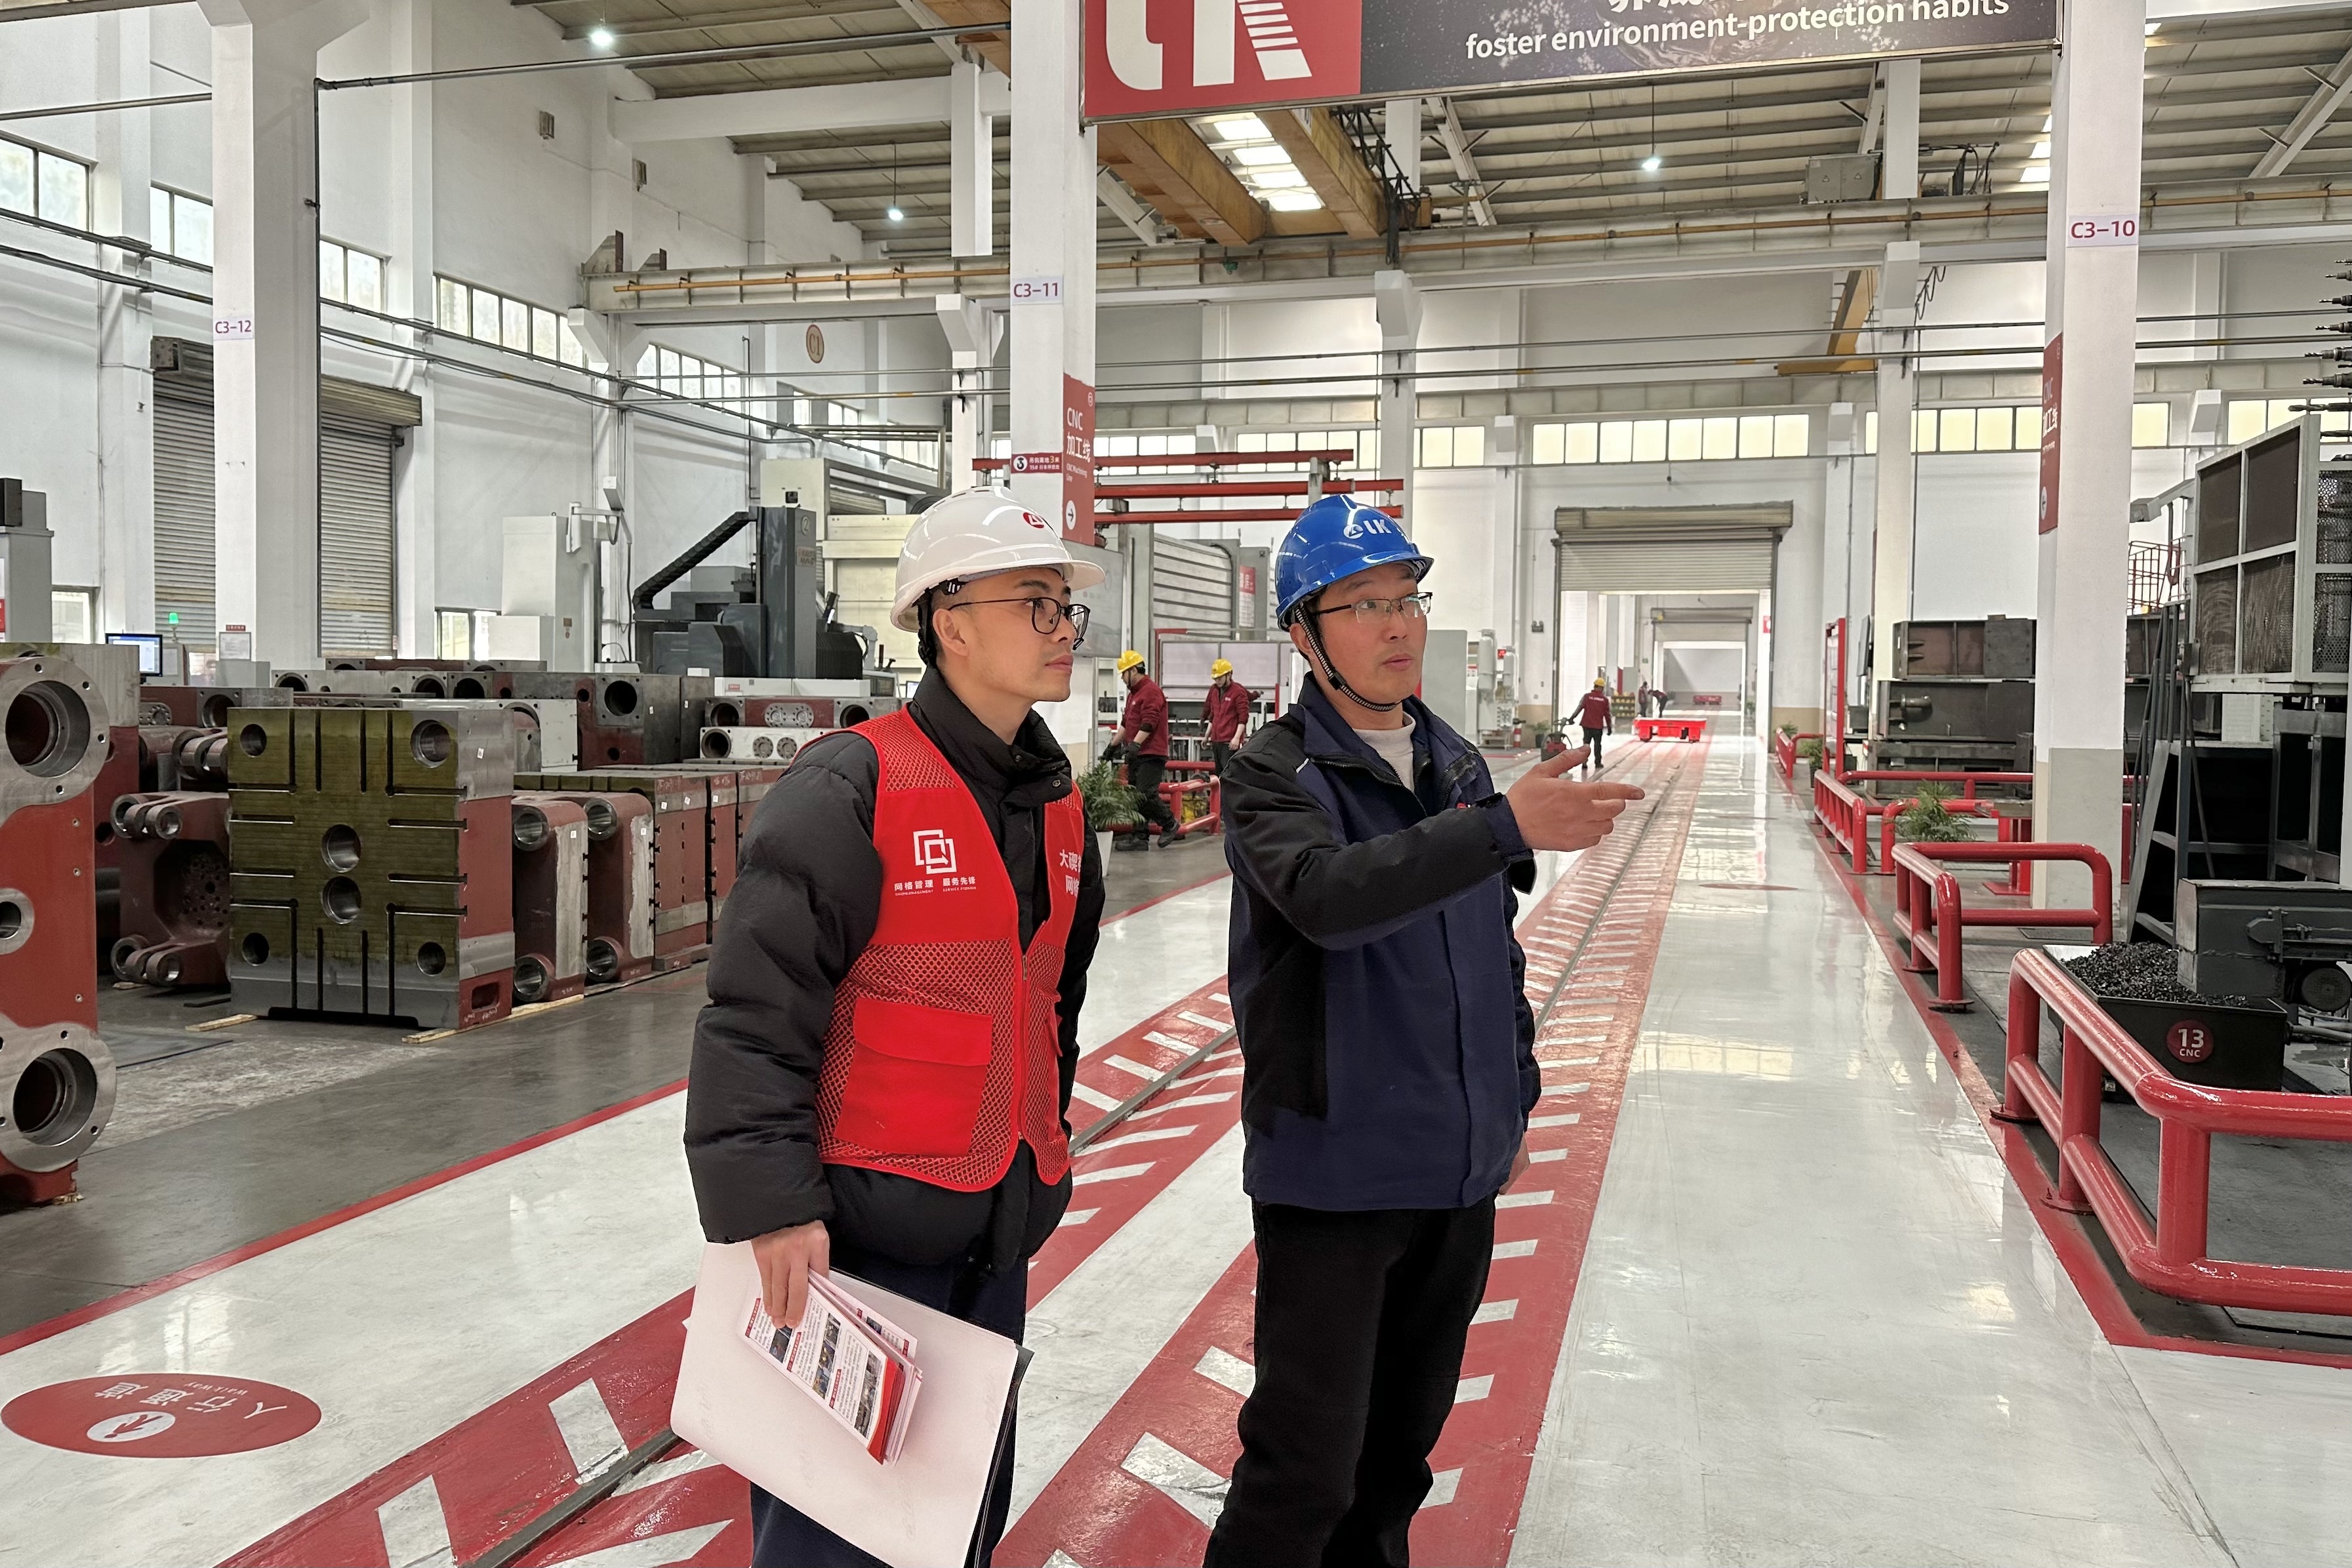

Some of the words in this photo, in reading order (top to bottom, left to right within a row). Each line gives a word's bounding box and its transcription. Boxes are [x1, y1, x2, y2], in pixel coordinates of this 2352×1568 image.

[1466, 33, 1547, 59] foster
[1551, 1, 1904, 51] environment-protection
[1913, 0, 2010, 20] habits
[2071, 220, 2136, 239] C3-10
[1013, 282, 1058, 298] C3-11
[215, 320, 252, 333] C3-12
[1066, 407, 1083, 431] CNC
[1066, 432, 1091, 463] 加工线
[894, 879, 933, 891] 网格管理
[943, 876, 976, 887] 服务先锋
[2178, 1028, 2204, 1048] 13
[2179, 1048, 2200, 1057] CNC
[94, 1381, 287, 1420] 人行通道
